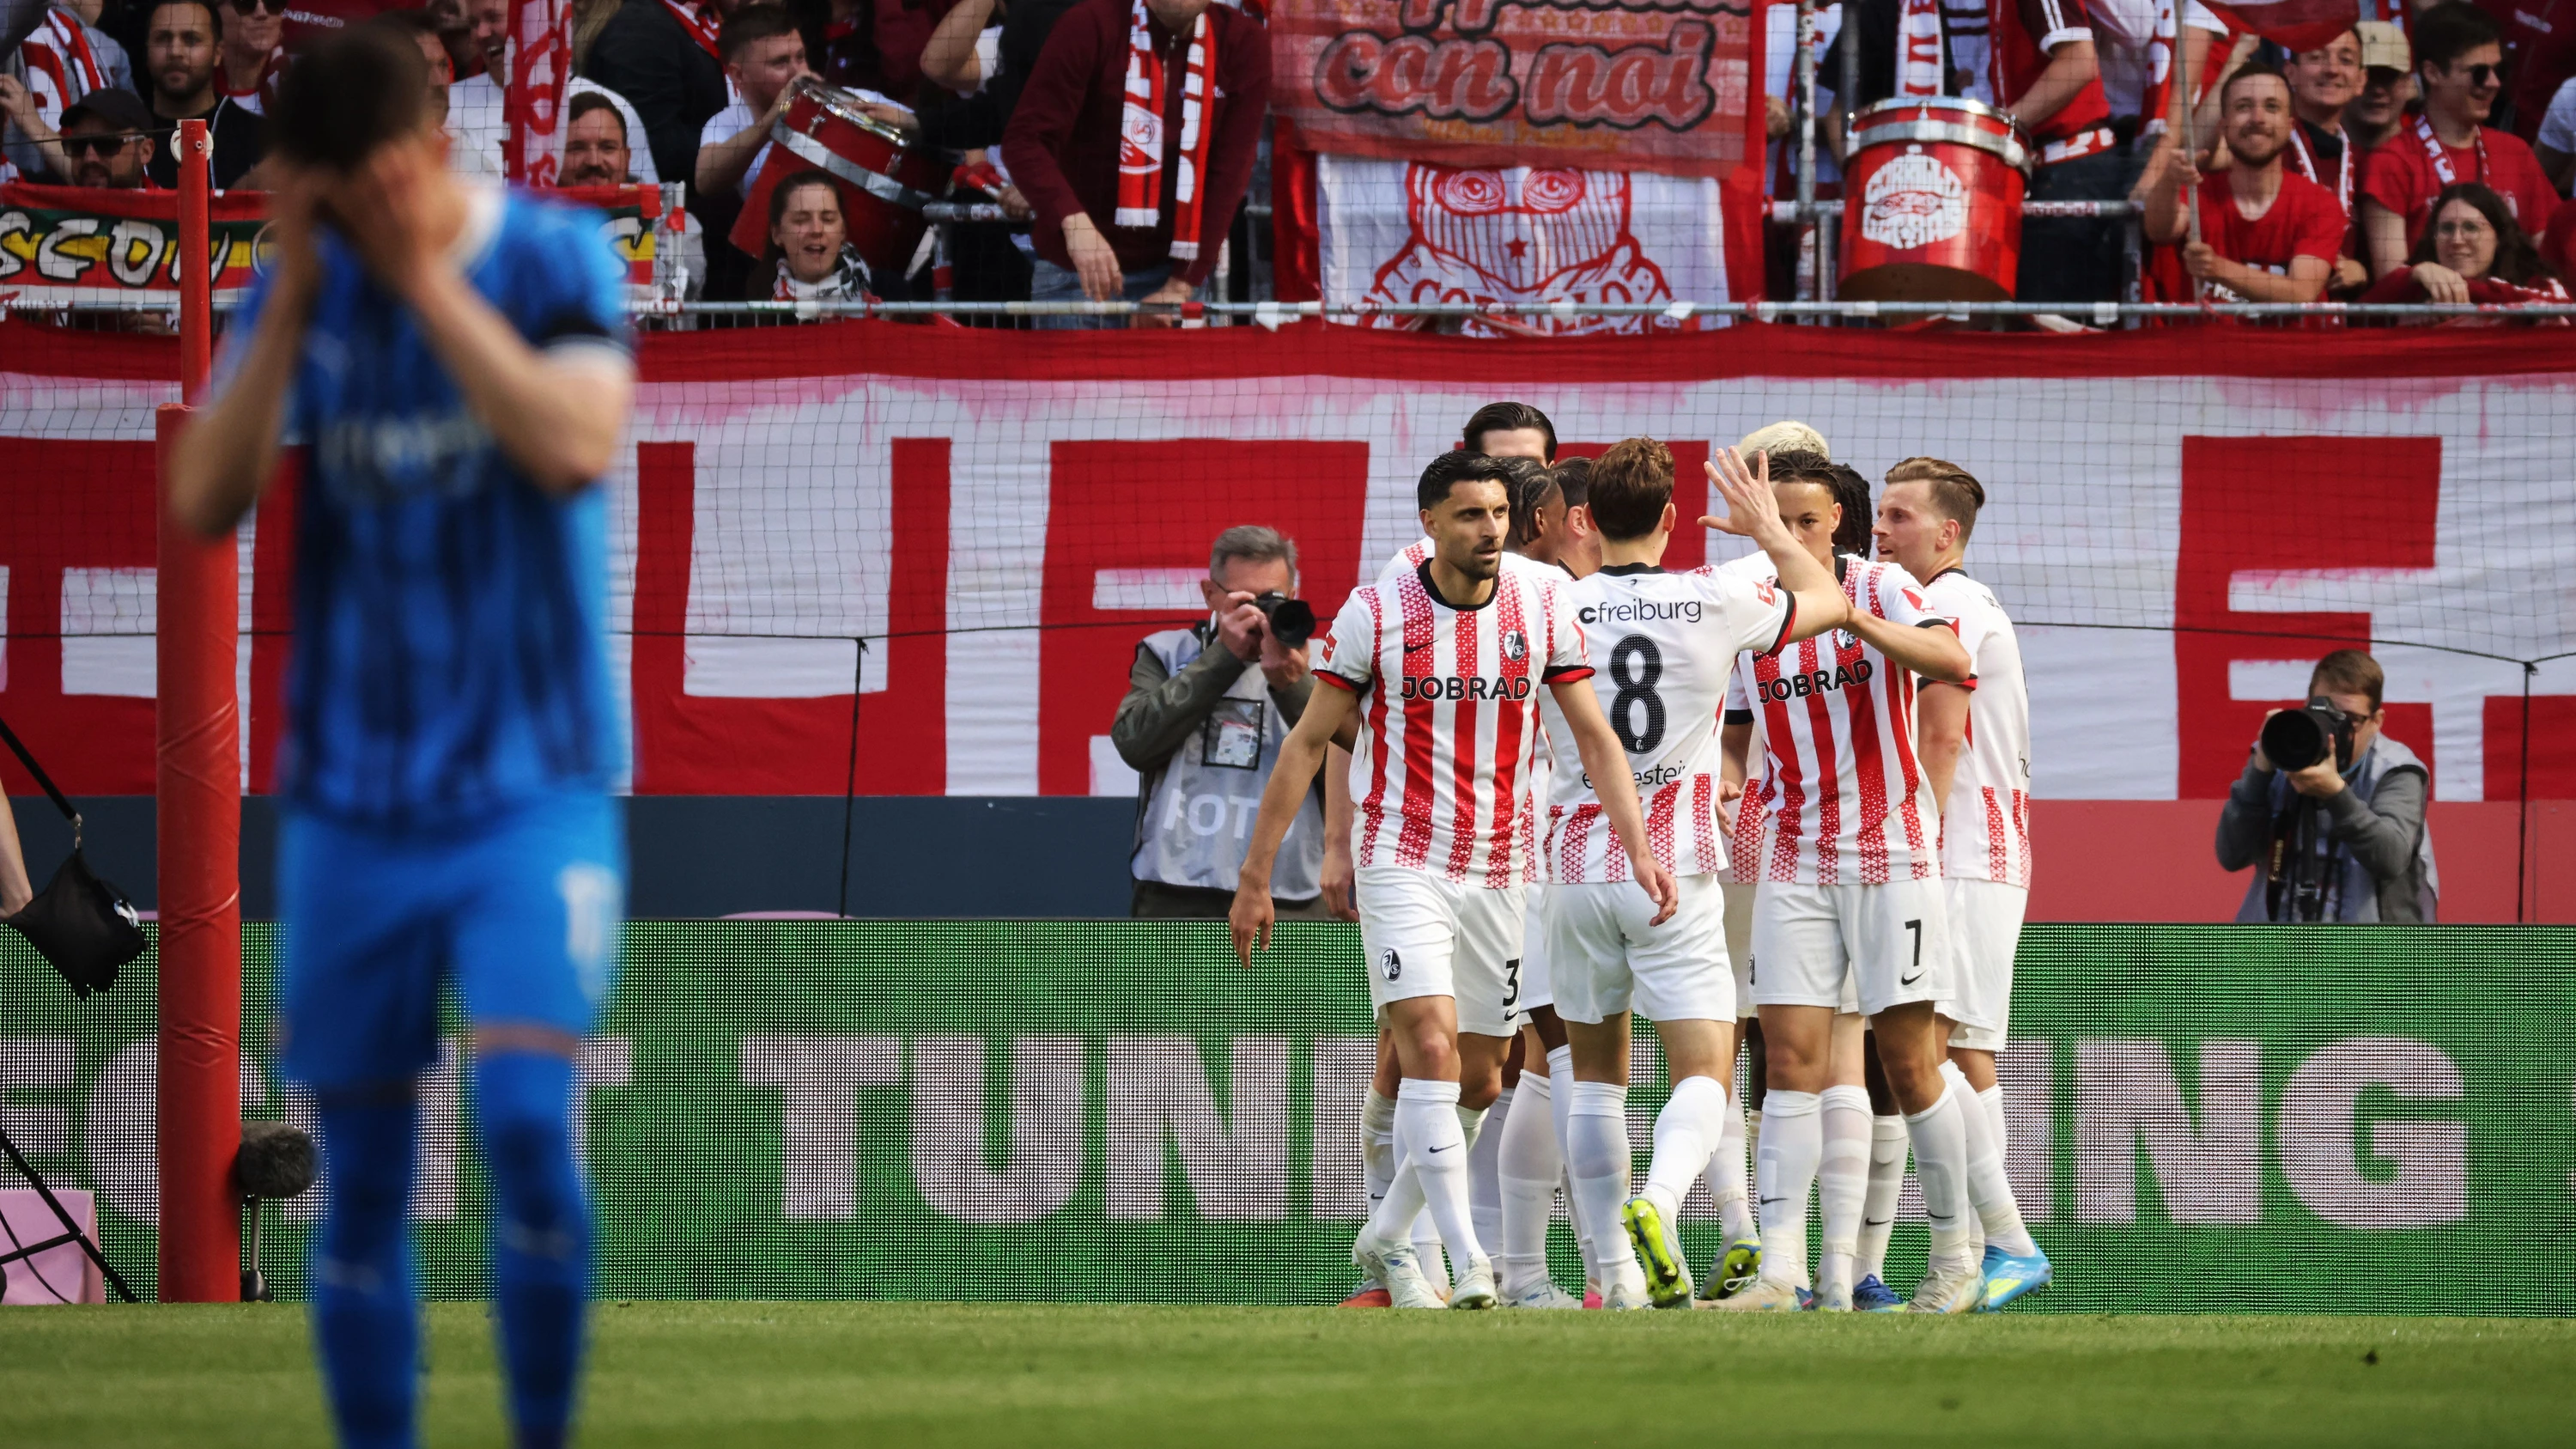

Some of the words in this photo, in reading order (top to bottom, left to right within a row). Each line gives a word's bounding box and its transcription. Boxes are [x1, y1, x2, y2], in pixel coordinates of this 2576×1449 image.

[1315, 29, 1520, 121] con
[1526, 18, 1717, 132] noi
[1400, 676, 1532, 701] JOBRAD
[1608, 633, 1667, 755] 8
[1758, 659, 1874, 704] JOBRAD
[1163, 788, 1295, 844] FOT
[1905, 919, 1923, 967] 7
[1502, 958, 1523, 1008] 3
